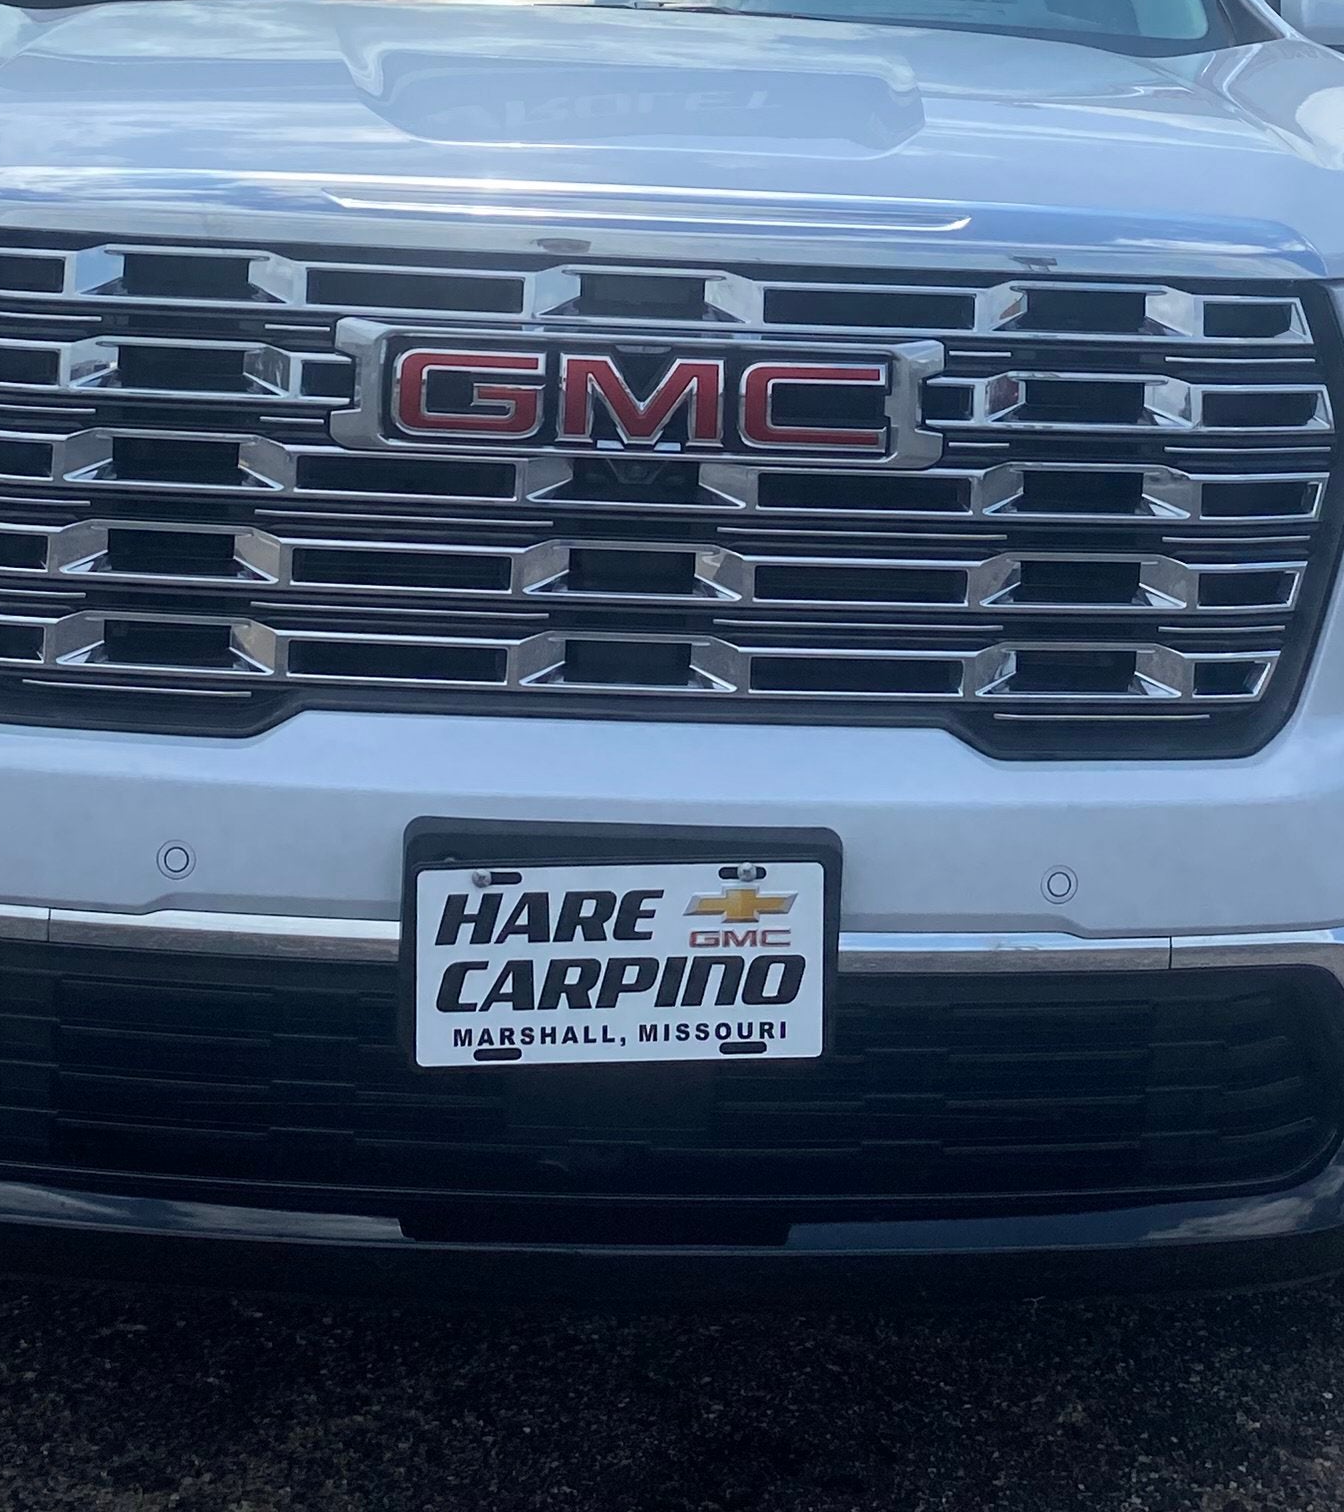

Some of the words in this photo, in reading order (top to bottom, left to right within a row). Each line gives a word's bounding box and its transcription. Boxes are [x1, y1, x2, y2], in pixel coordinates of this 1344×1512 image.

[396, 348, 887, 452] GMC
[434, 890, 664, 946] HARE
[689, 927, 792, 948] GMC
[435, 954, 806, 1013] CARPINO
[453, 1024, 626, 1048] MARSHALL,
[639, 1021, 787, 1042] MISSOURI
